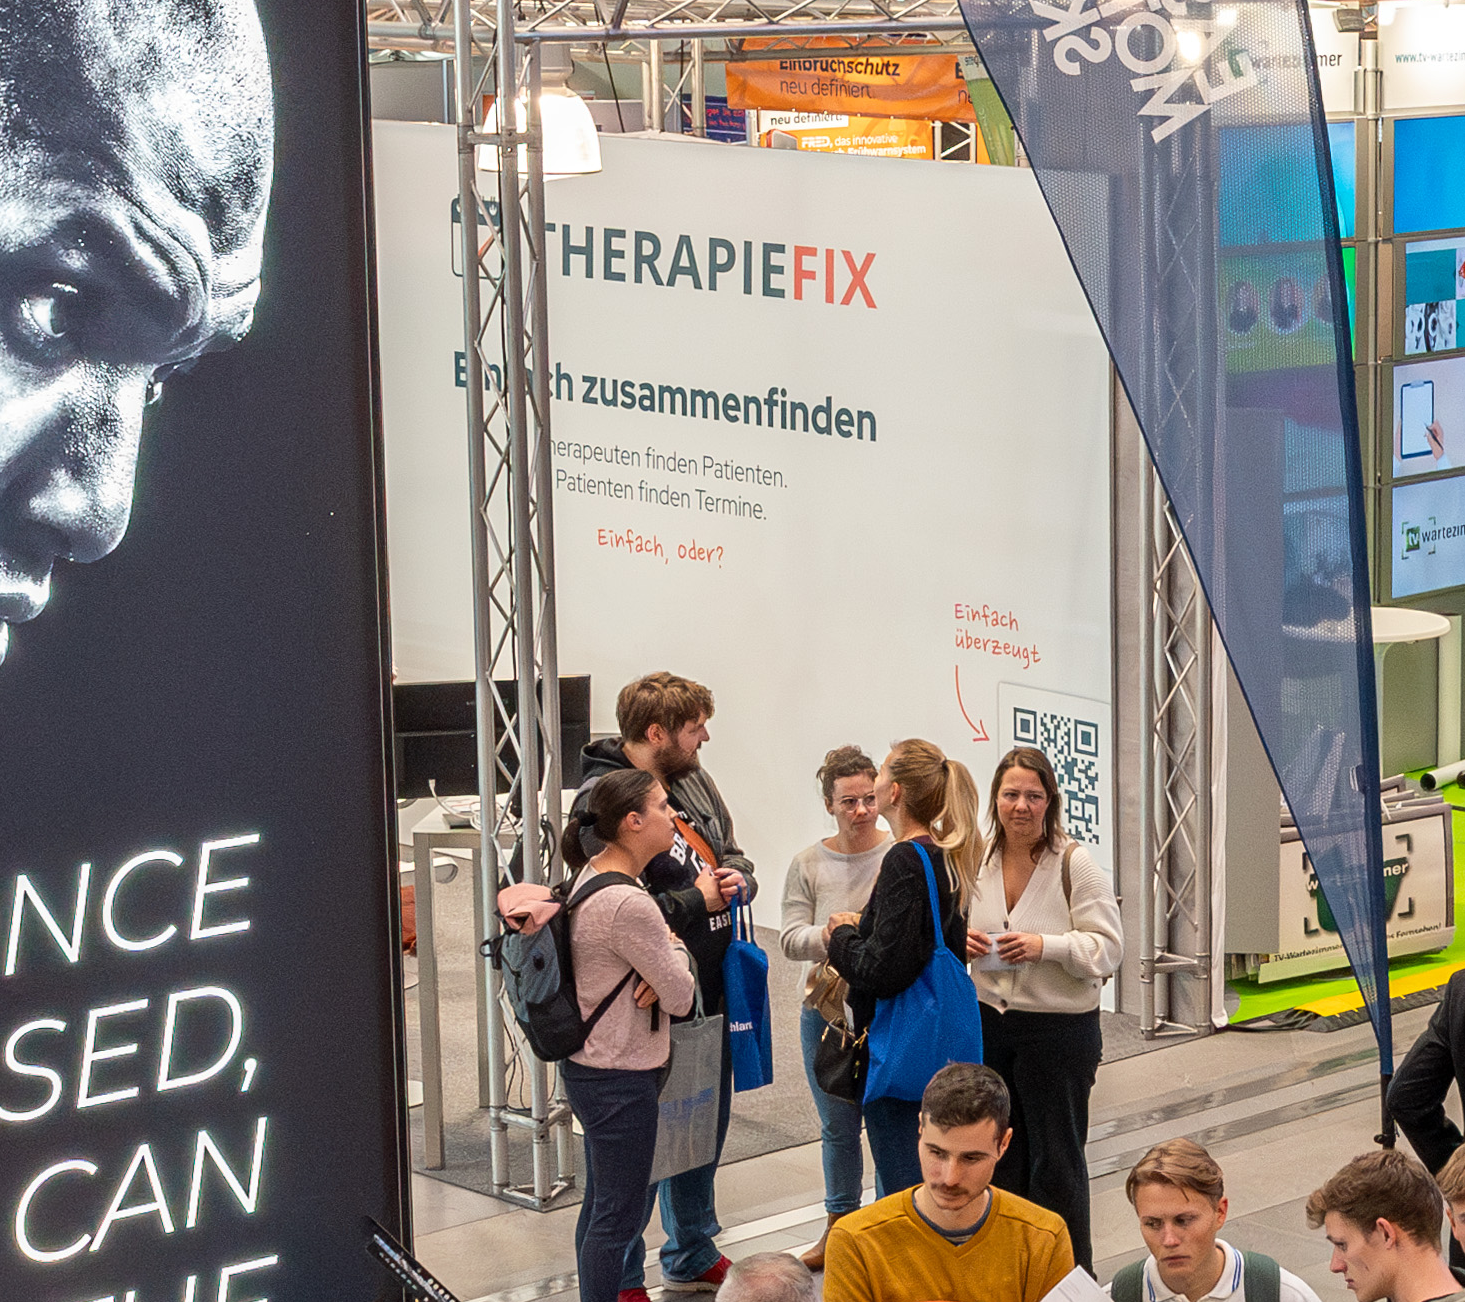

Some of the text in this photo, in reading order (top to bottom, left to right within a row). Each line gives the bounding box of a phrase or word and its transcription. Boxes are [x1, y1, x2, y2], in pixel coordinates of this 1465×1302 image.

[779, 57, 901, 77] Einbruchschutz
[779, 79, 807, 95] neu
[834, 135, 851, 147] das
[852, 133, 899, 146] innovative
[582, 373, 878, 442] zusammenfinden
[550, 437, 788, 489] herapeuten finden Patienten.
[555, 468, 767, 521] Patienten finden Termine.
[597, 527, 724, 569] Einfach, oder?
[954, 602, 1020, 632] Einfach
[954, 628, 1041, 669] überzeugt
[14, 1117, 270, 1265] CAN
